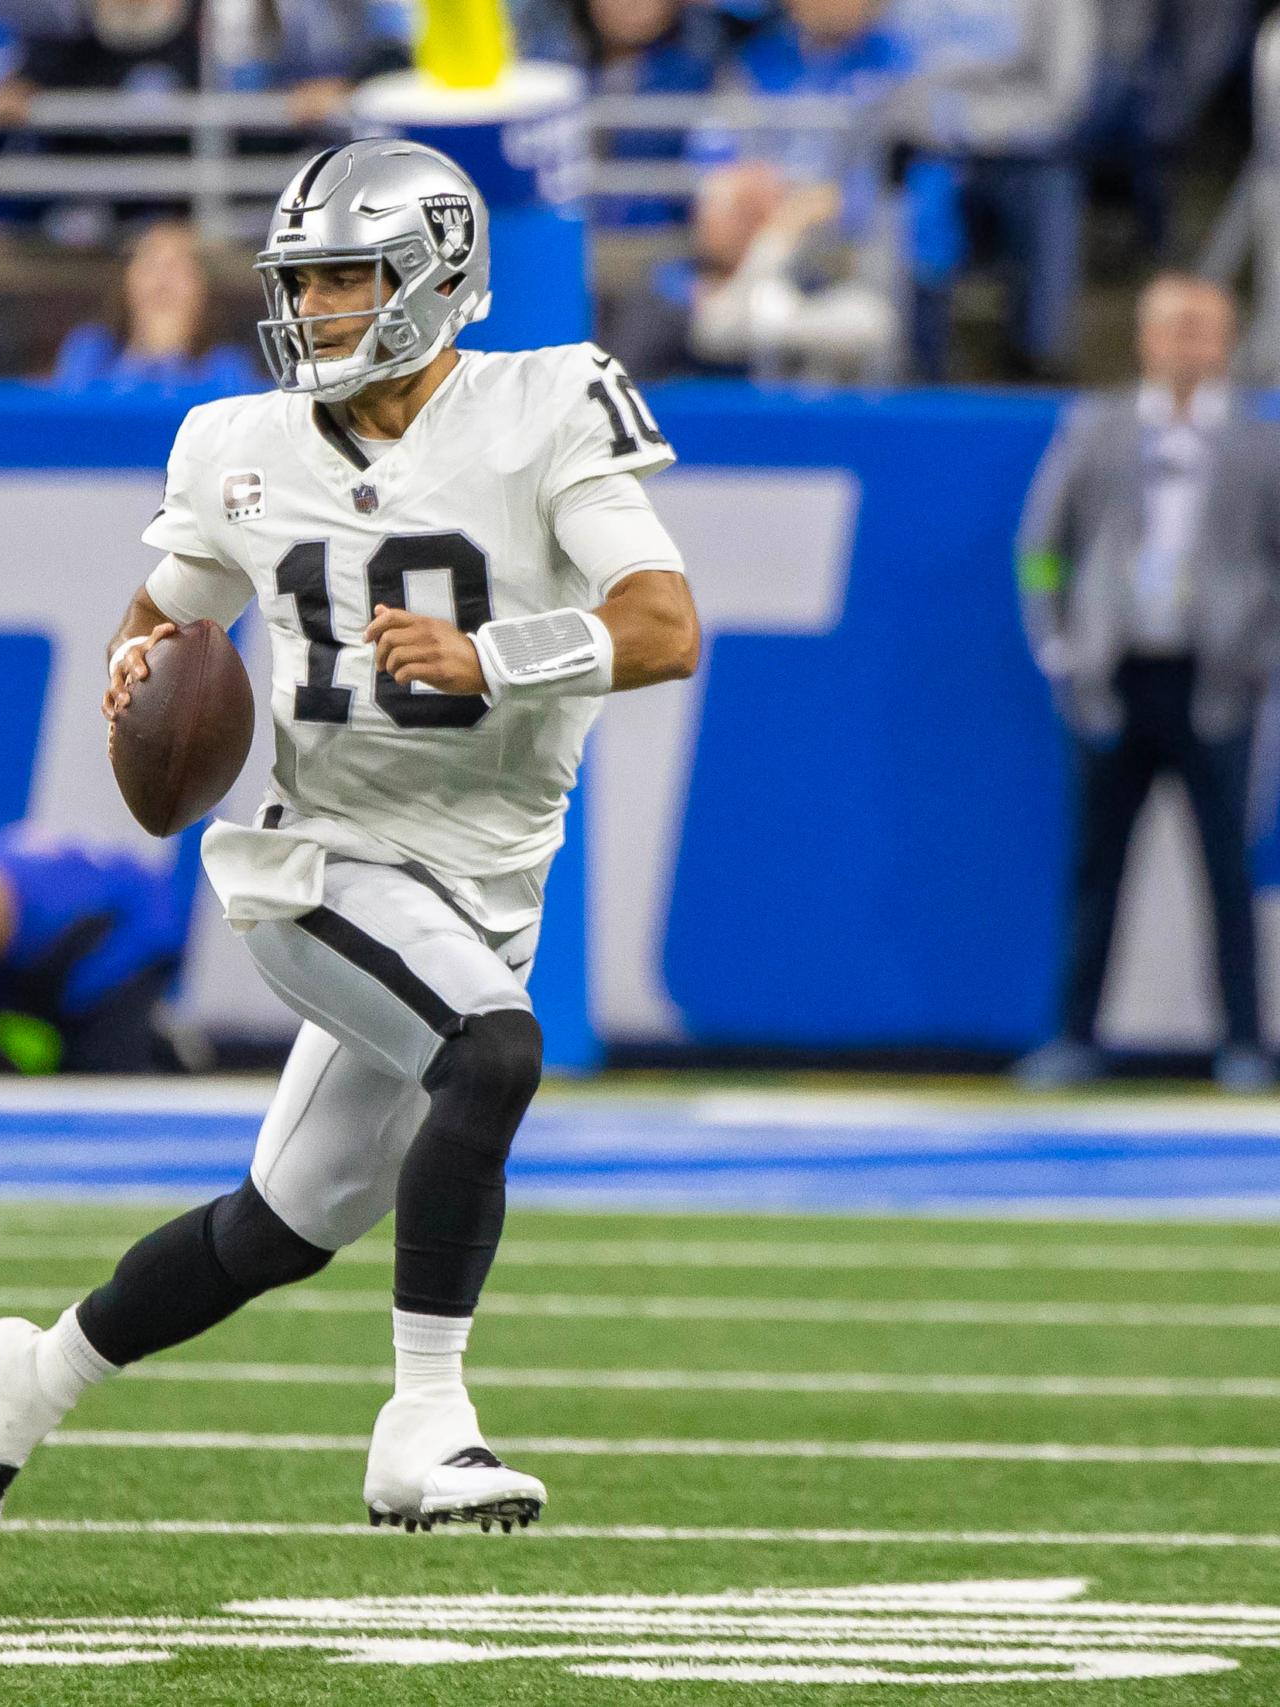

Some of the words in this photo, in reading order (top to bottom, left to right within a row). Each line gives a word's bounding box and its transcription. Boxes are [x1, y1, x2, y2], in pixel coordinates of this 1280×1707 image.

[426, 196, 468, 208] RAIDERS
[223, 472, 262, 510] C
[272, 529, 496, 731] 10
